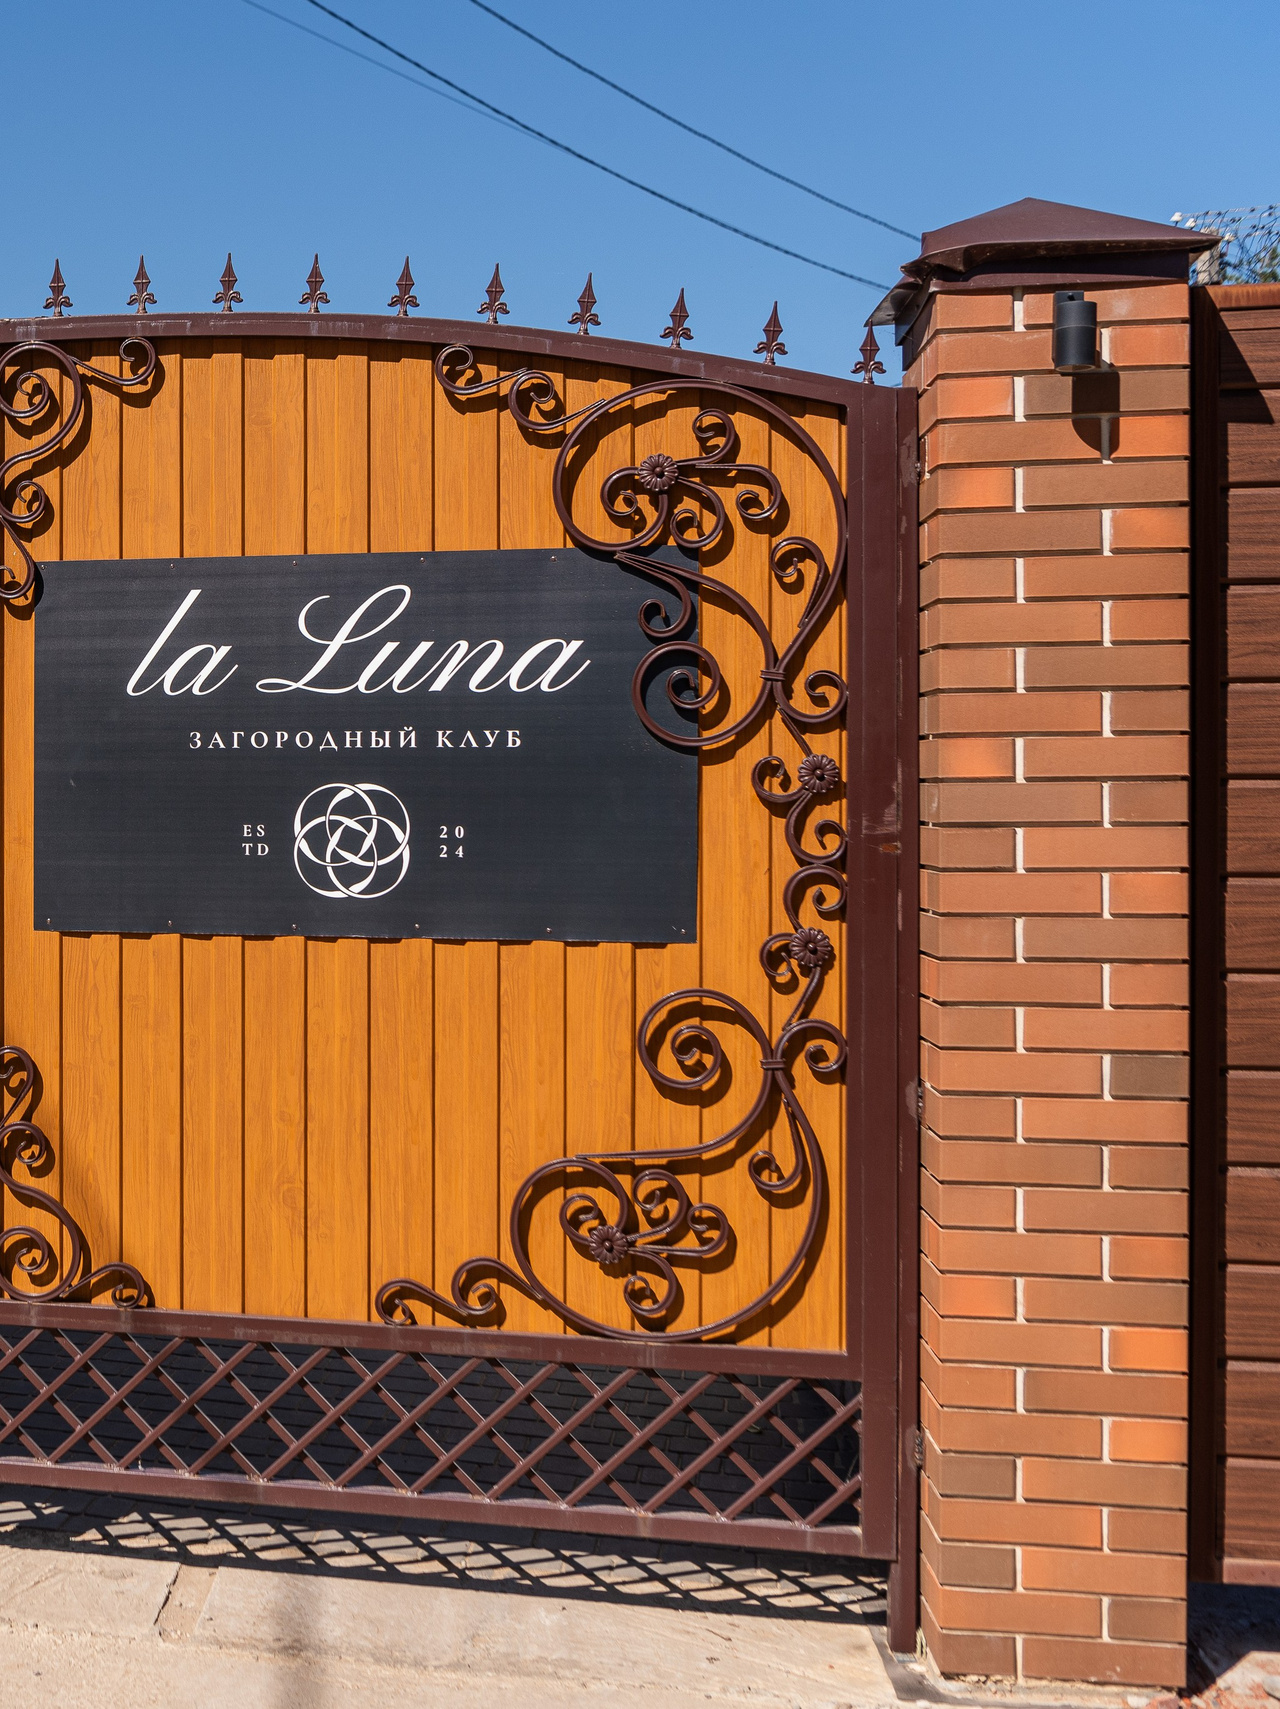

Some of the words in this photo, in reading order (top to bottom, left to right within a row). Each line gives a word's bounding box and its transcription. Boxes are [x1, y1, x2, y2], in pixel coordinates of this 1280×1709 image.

[127, 588, 238, 697] la
[256, 584, 591, 694] Luna
[189, 726, 417, 752] ЗАГОРОДНЫЙ
[436, 729, 521, 749] КЛУБ
[243, 824, 265, 837] ES
[439, 825, 465, 839] 20
[242, 843, 269, 856] TD
[439, 844, 464, 858] 24
